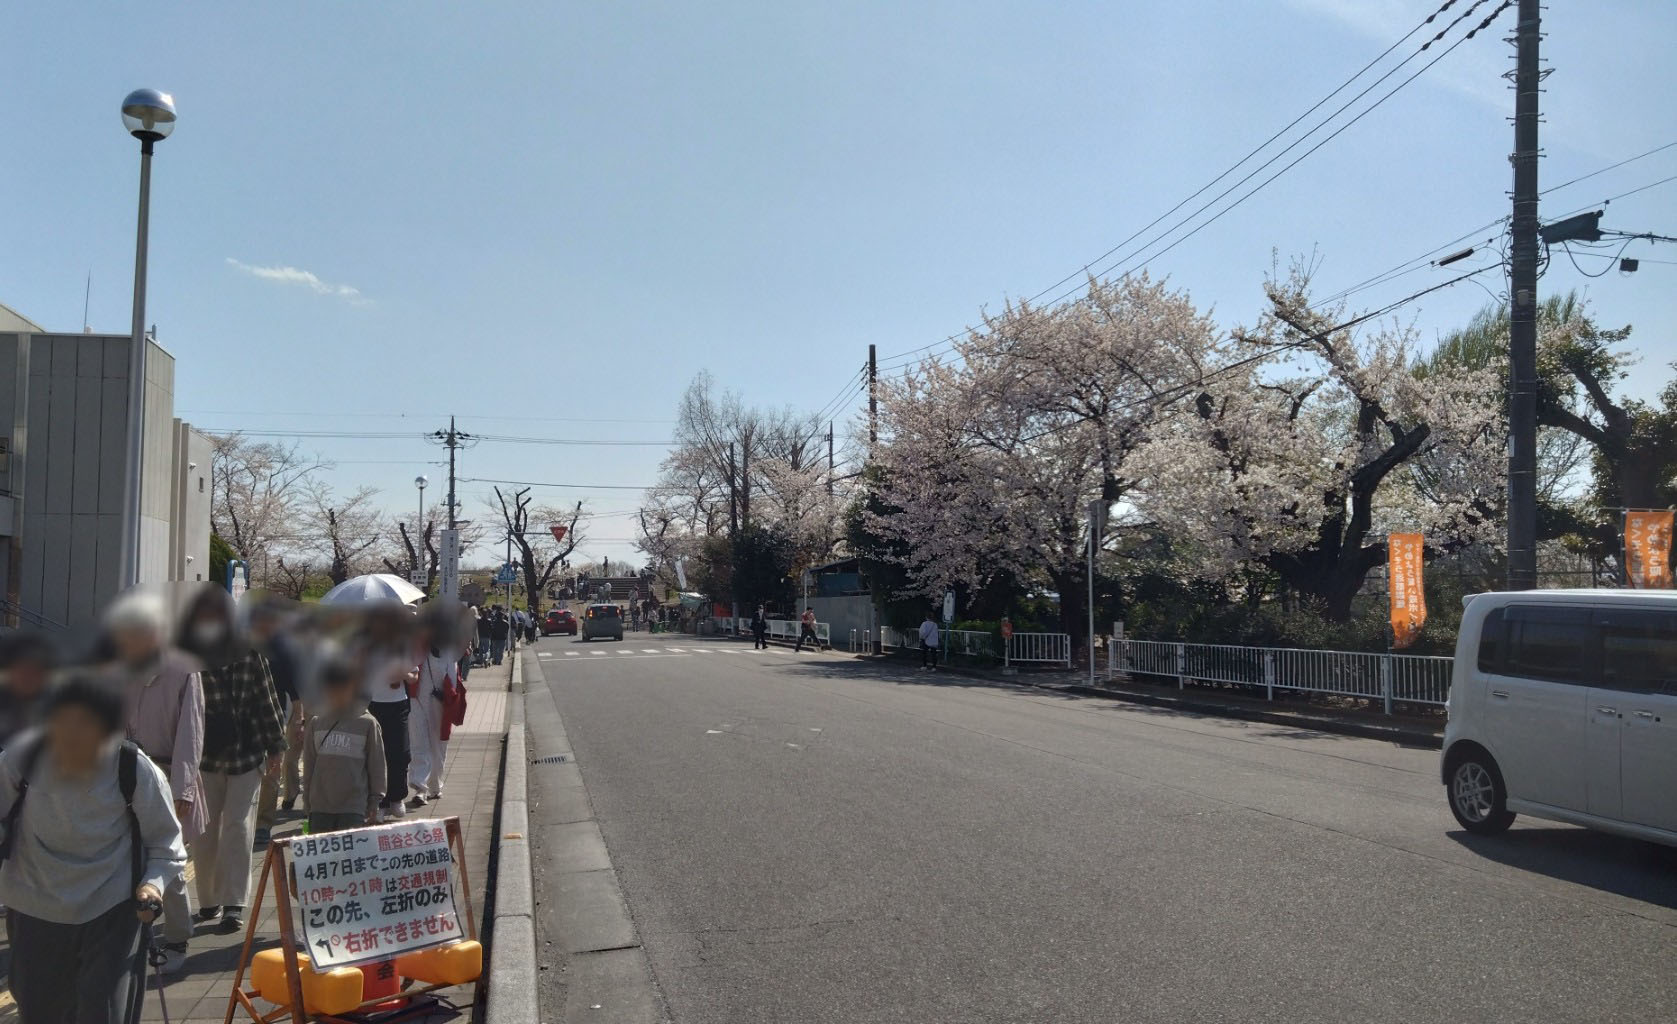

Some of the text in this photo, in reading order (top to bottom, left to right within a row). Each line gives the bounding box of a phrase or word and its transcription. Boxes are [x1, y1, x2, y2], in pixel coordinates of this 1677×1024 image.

[378, 827, 445, 851] 熊谷さくら祭
[304, 848, 450, 881] 4月7日までこの先の道路
[342, 914, 455, 955] 右折できません
